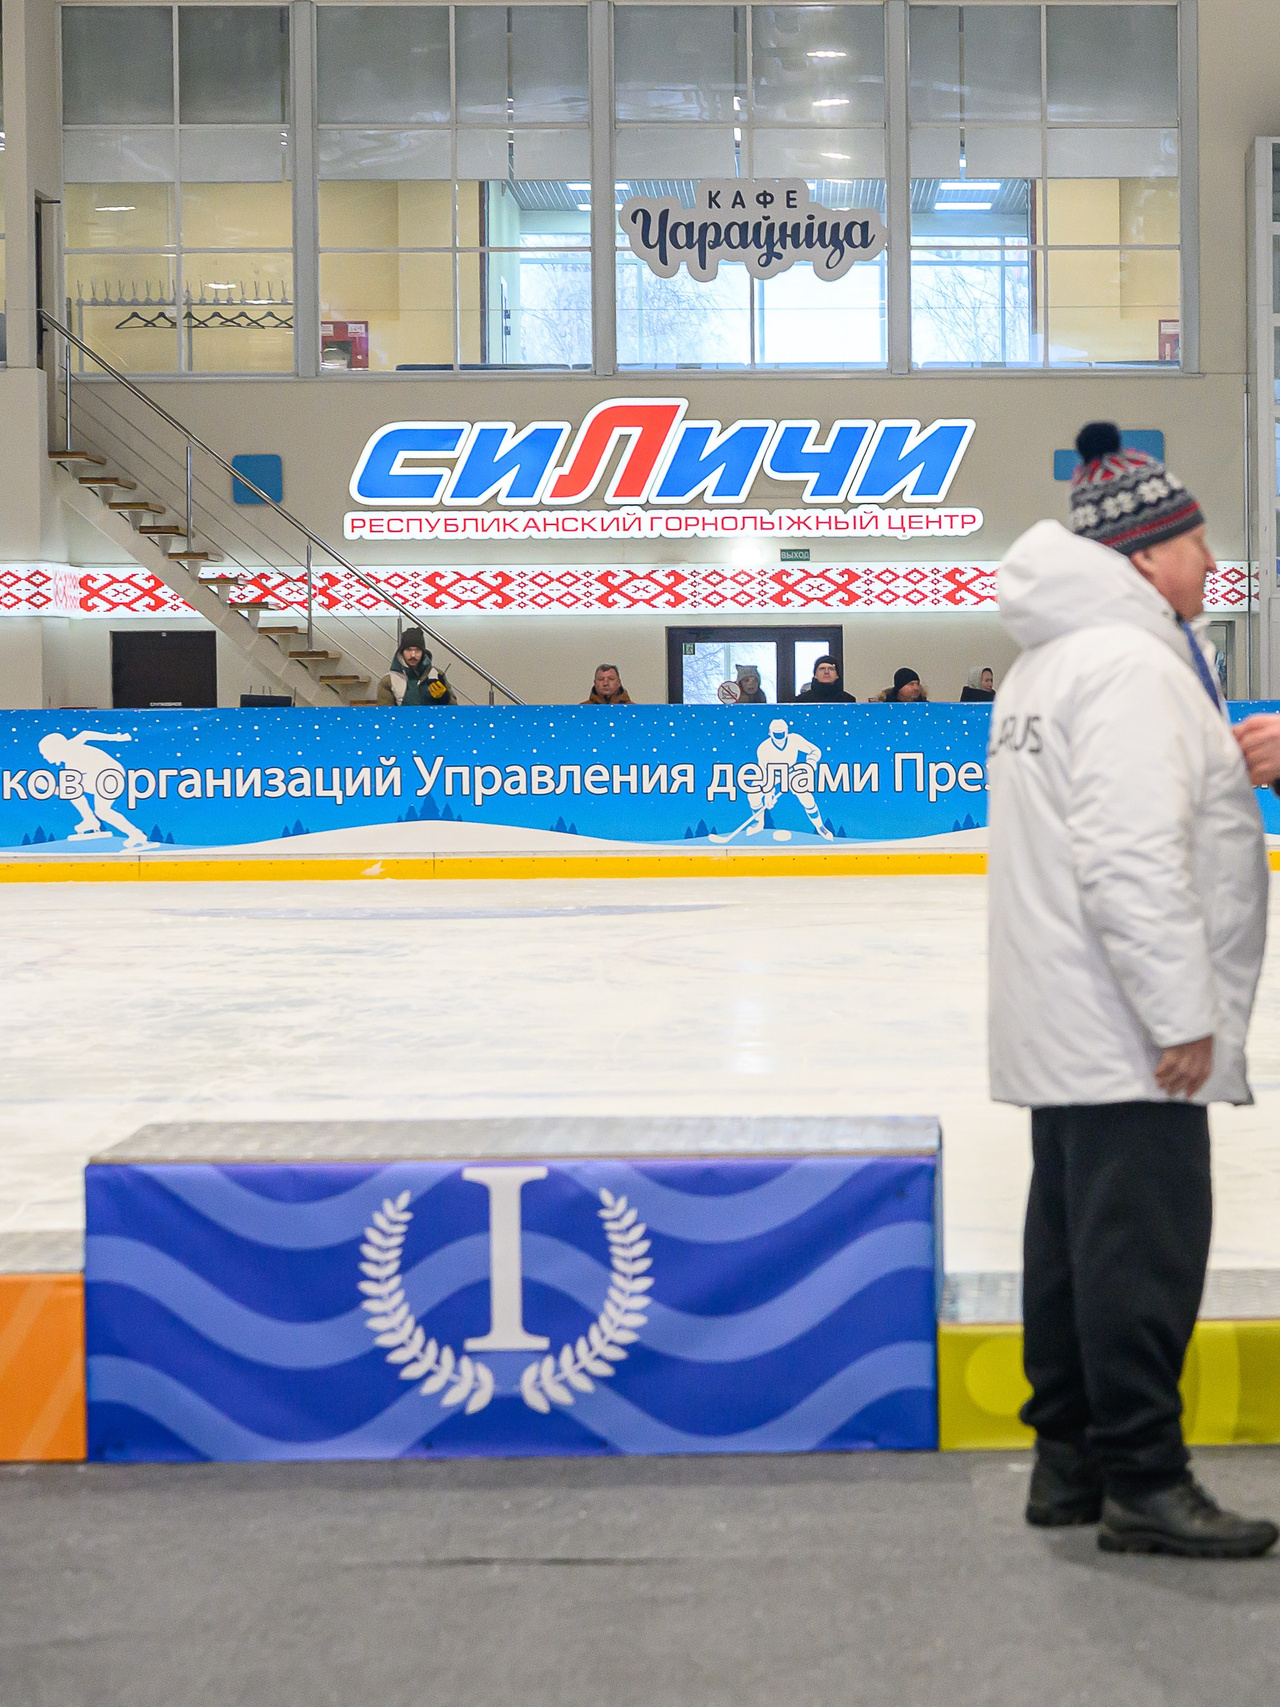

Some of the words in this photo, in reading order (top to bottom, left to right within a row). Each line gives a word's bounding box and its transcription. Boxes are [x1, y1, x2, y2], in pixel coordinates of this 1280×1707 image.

[707, 190, 798, 209] КАФЕ
[630, 208, 876, 270] Чараўніца
[350, 512, 642, 533] РЕСПУБЛИКАНСКИЙ
[650, 511, 879, 531] ГОРНОЛЫЖНЫЙ
[888, 514, 977, 533] ЦЕНТР
[781, 551, 810, 560] ВЫХОД
[1, 768, 85, 801] ков
[95, 756, 402, 810] организаций
[412, 756, 696, 806] Управления
[706, 762, 880, 802] делами
[893, 752, 990, 803] Пре
[462, 1166, 551, 1351] I
